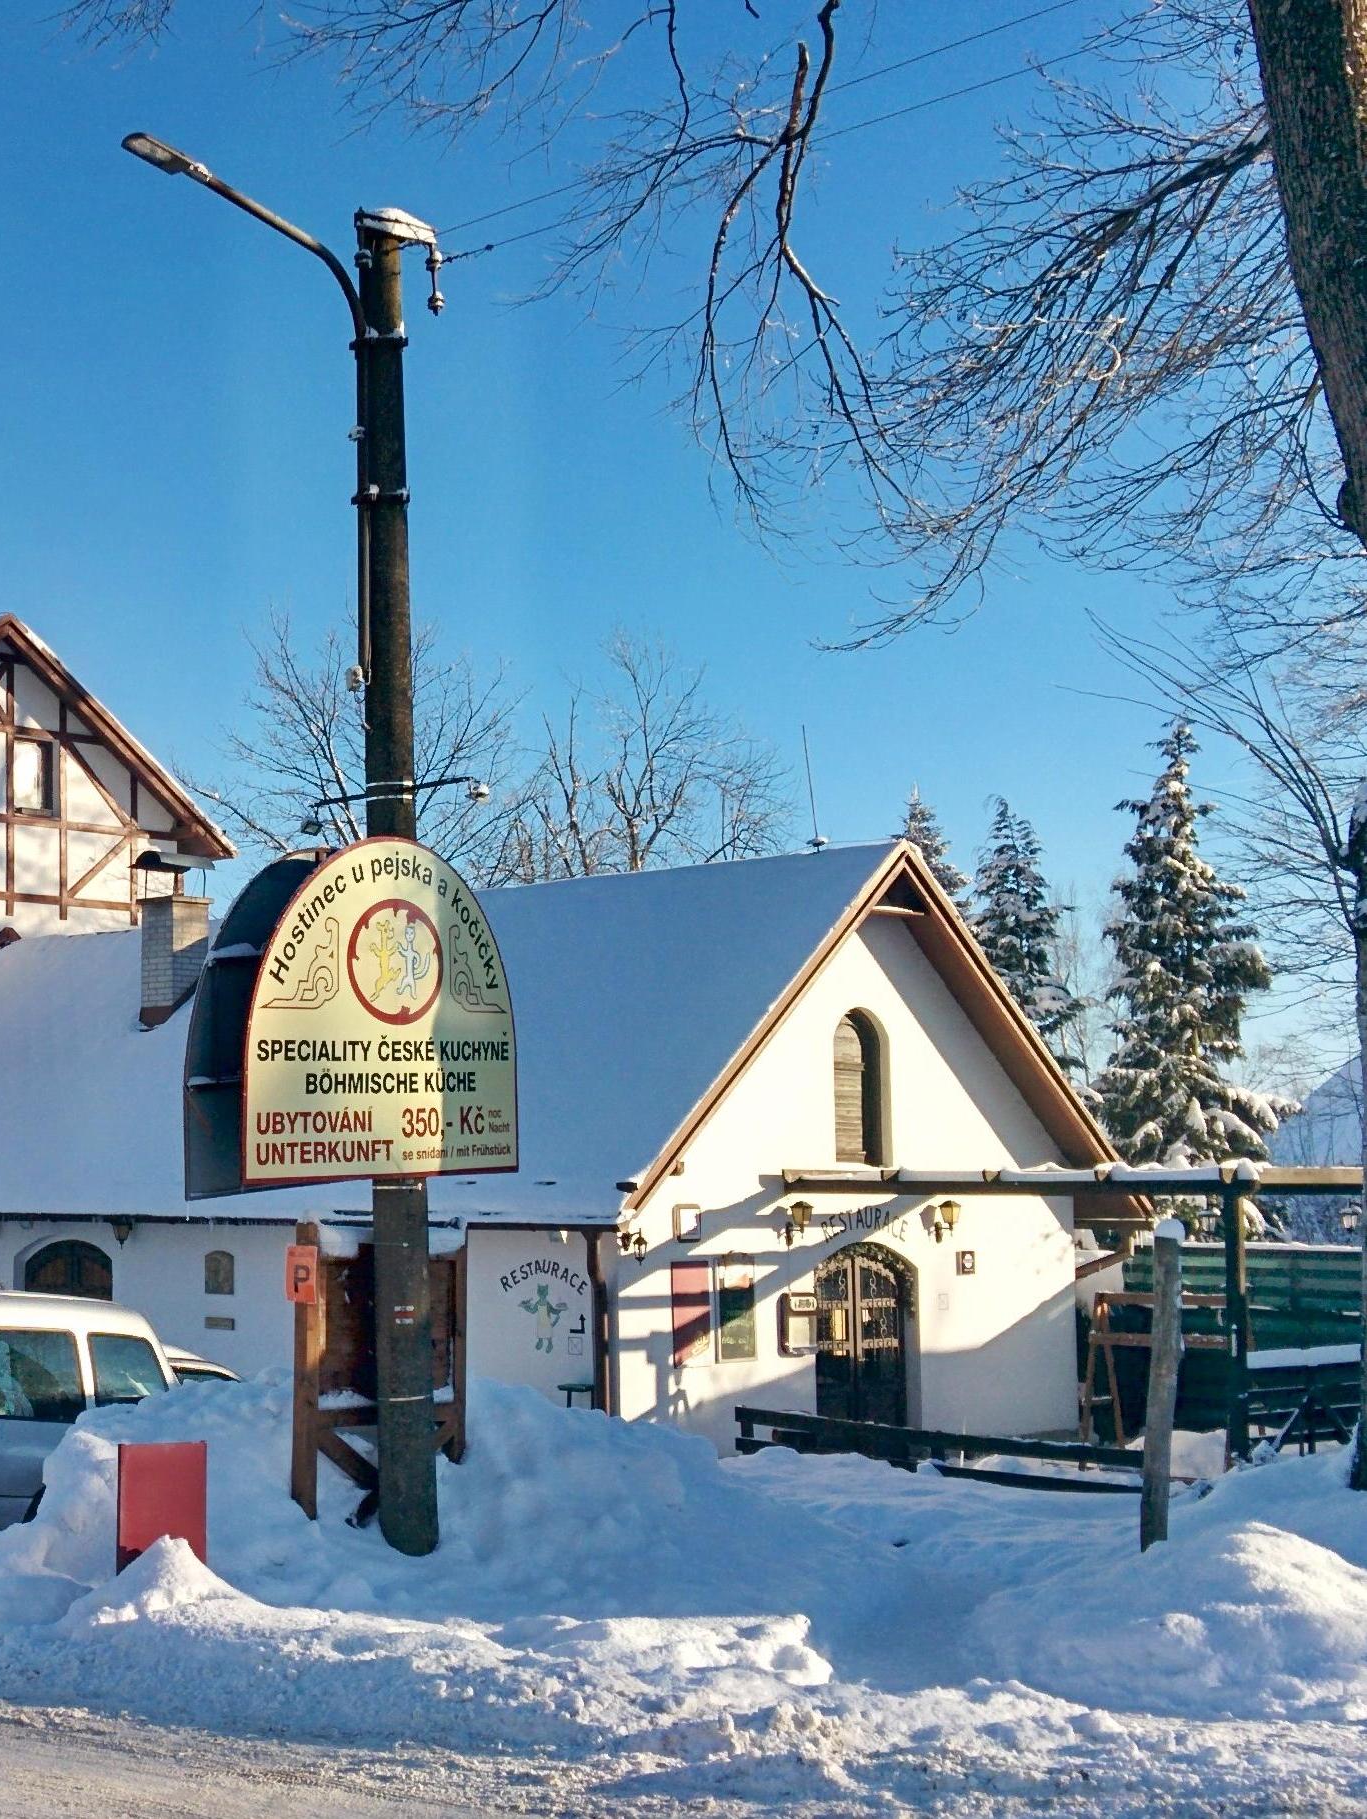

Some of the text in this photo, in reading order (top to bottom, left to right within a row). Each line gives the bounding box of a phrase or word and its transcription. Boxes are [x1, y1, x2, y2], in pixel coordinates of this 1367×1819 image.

[269, 851, 499, 989] Hostinec u pejska a kočičky
[256, 1032, 509, 1062] SPECIALITY ČESKÉ KUCHYNĚ
[305, 1067, 476, 1095] BÖHMISCHE KÜCHE
[256, 1105, 485, 1141] UBYTOVÁNÍ 350,- Kč
[488, 1109, 501, 1119] noc
[488, 1121, 510, 1133] Nacht
[256, 1140, 394, 1166] UNTERKUNFT
[402, 1150, 413, 1160] se
[456, 1145, 470, 1158] mit
[471, 1143, 512, 1157] Frühstück
[820, 1205, 908, 1243] RESTAURACE
[293, 1264, 310, 1293] P
[499, 1259, 588, 1295] RESTAURACE
